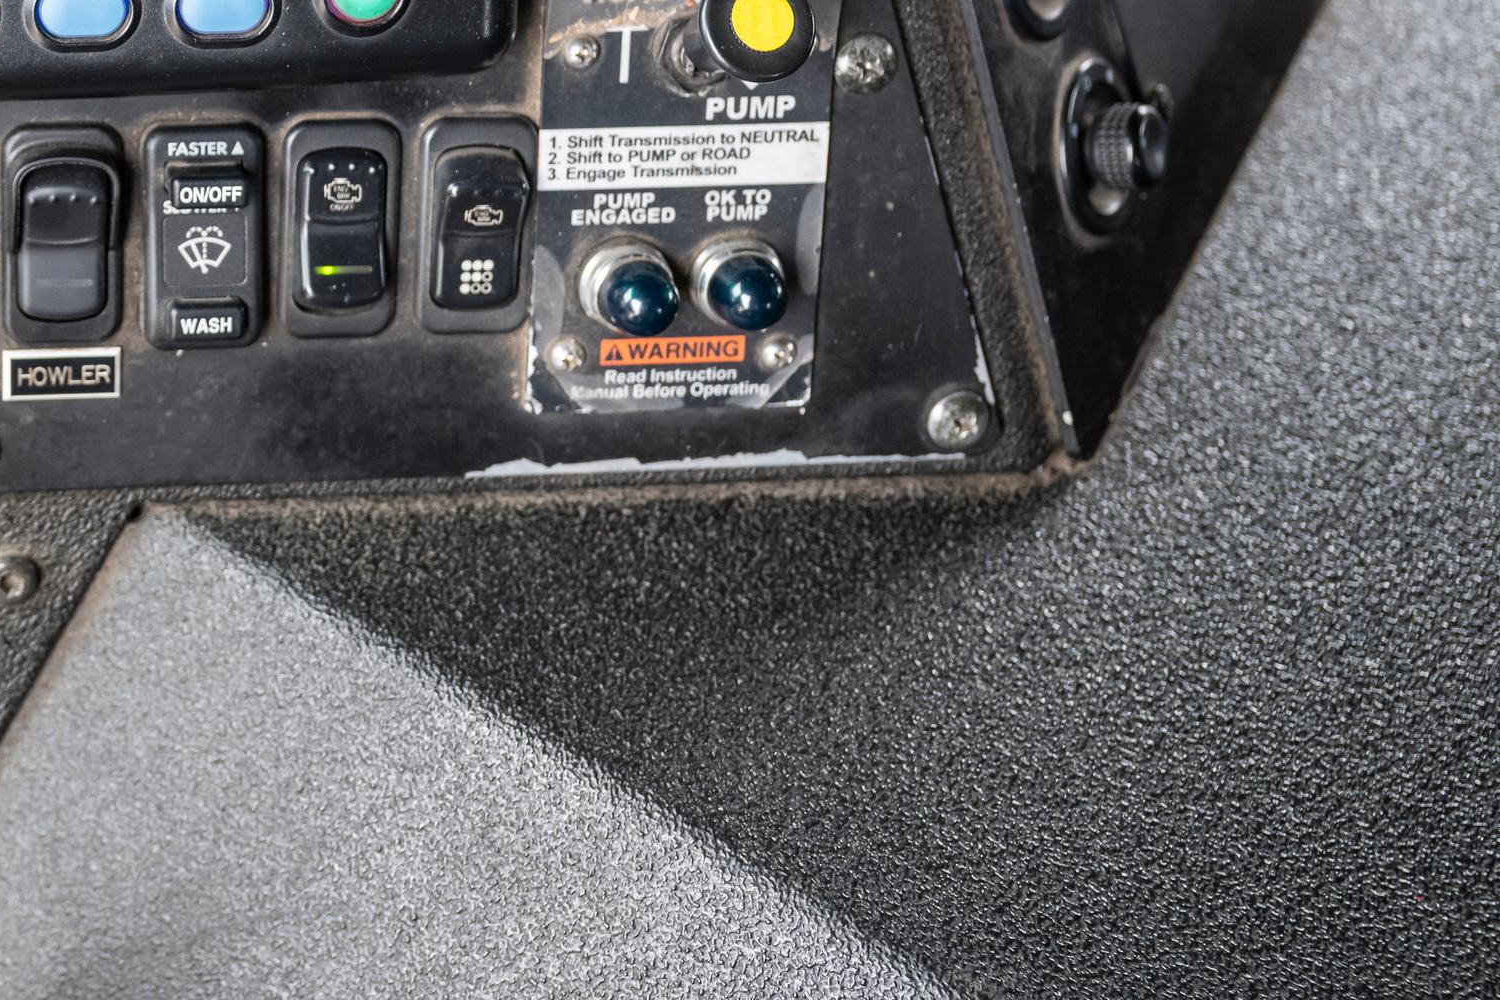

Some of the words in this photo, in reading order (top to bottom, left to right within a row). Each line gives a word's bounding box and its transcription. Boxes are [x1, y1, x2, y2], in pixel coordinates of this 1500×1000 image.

[705, 94, 796, 121] PUMP
[167, 140, 229, 157] FASTER
[549, 136, 562, 149] 1.
[567, 135, 604, 149] Shift
[609, 132, 715, 148] Transmission
[720, 133, 736, 145] to
[740, 129, 820, 144] NEUTRAL
[548, 151, 562, 165] 2.
[566, 150, 603, 165] Shift
[608, 151, 623, 163] to
[628, 149, 676, 163] PUMP
[680, 150, 697, 162] or
[701, 147, 751, 161] ROAD
[547, 167, 560, 181] 3.
[566, 165, 626, 183] Engage
[631, 163, 738, 179] Transmission
[179, 185, 244, 204] ON/OFF
[592, 191, 656, 209] PUMP
[703, 190, 738, 206] OK
[742, 188, 772, 205] TO
[570, 207, 676, 226] ENGAGED
[706, 204, 768, 222] PUMP
[180, 315, 234, 336] WASH
[628, 339, 740, 361] WARNING
[16, 363, 112, 388] HOWLER
[603, 368, 647, 385] Read
[650, 366, 738, 384] Instruction
[632, 383, 687, 399] Before
[690, 380, 771, 400] Operating
